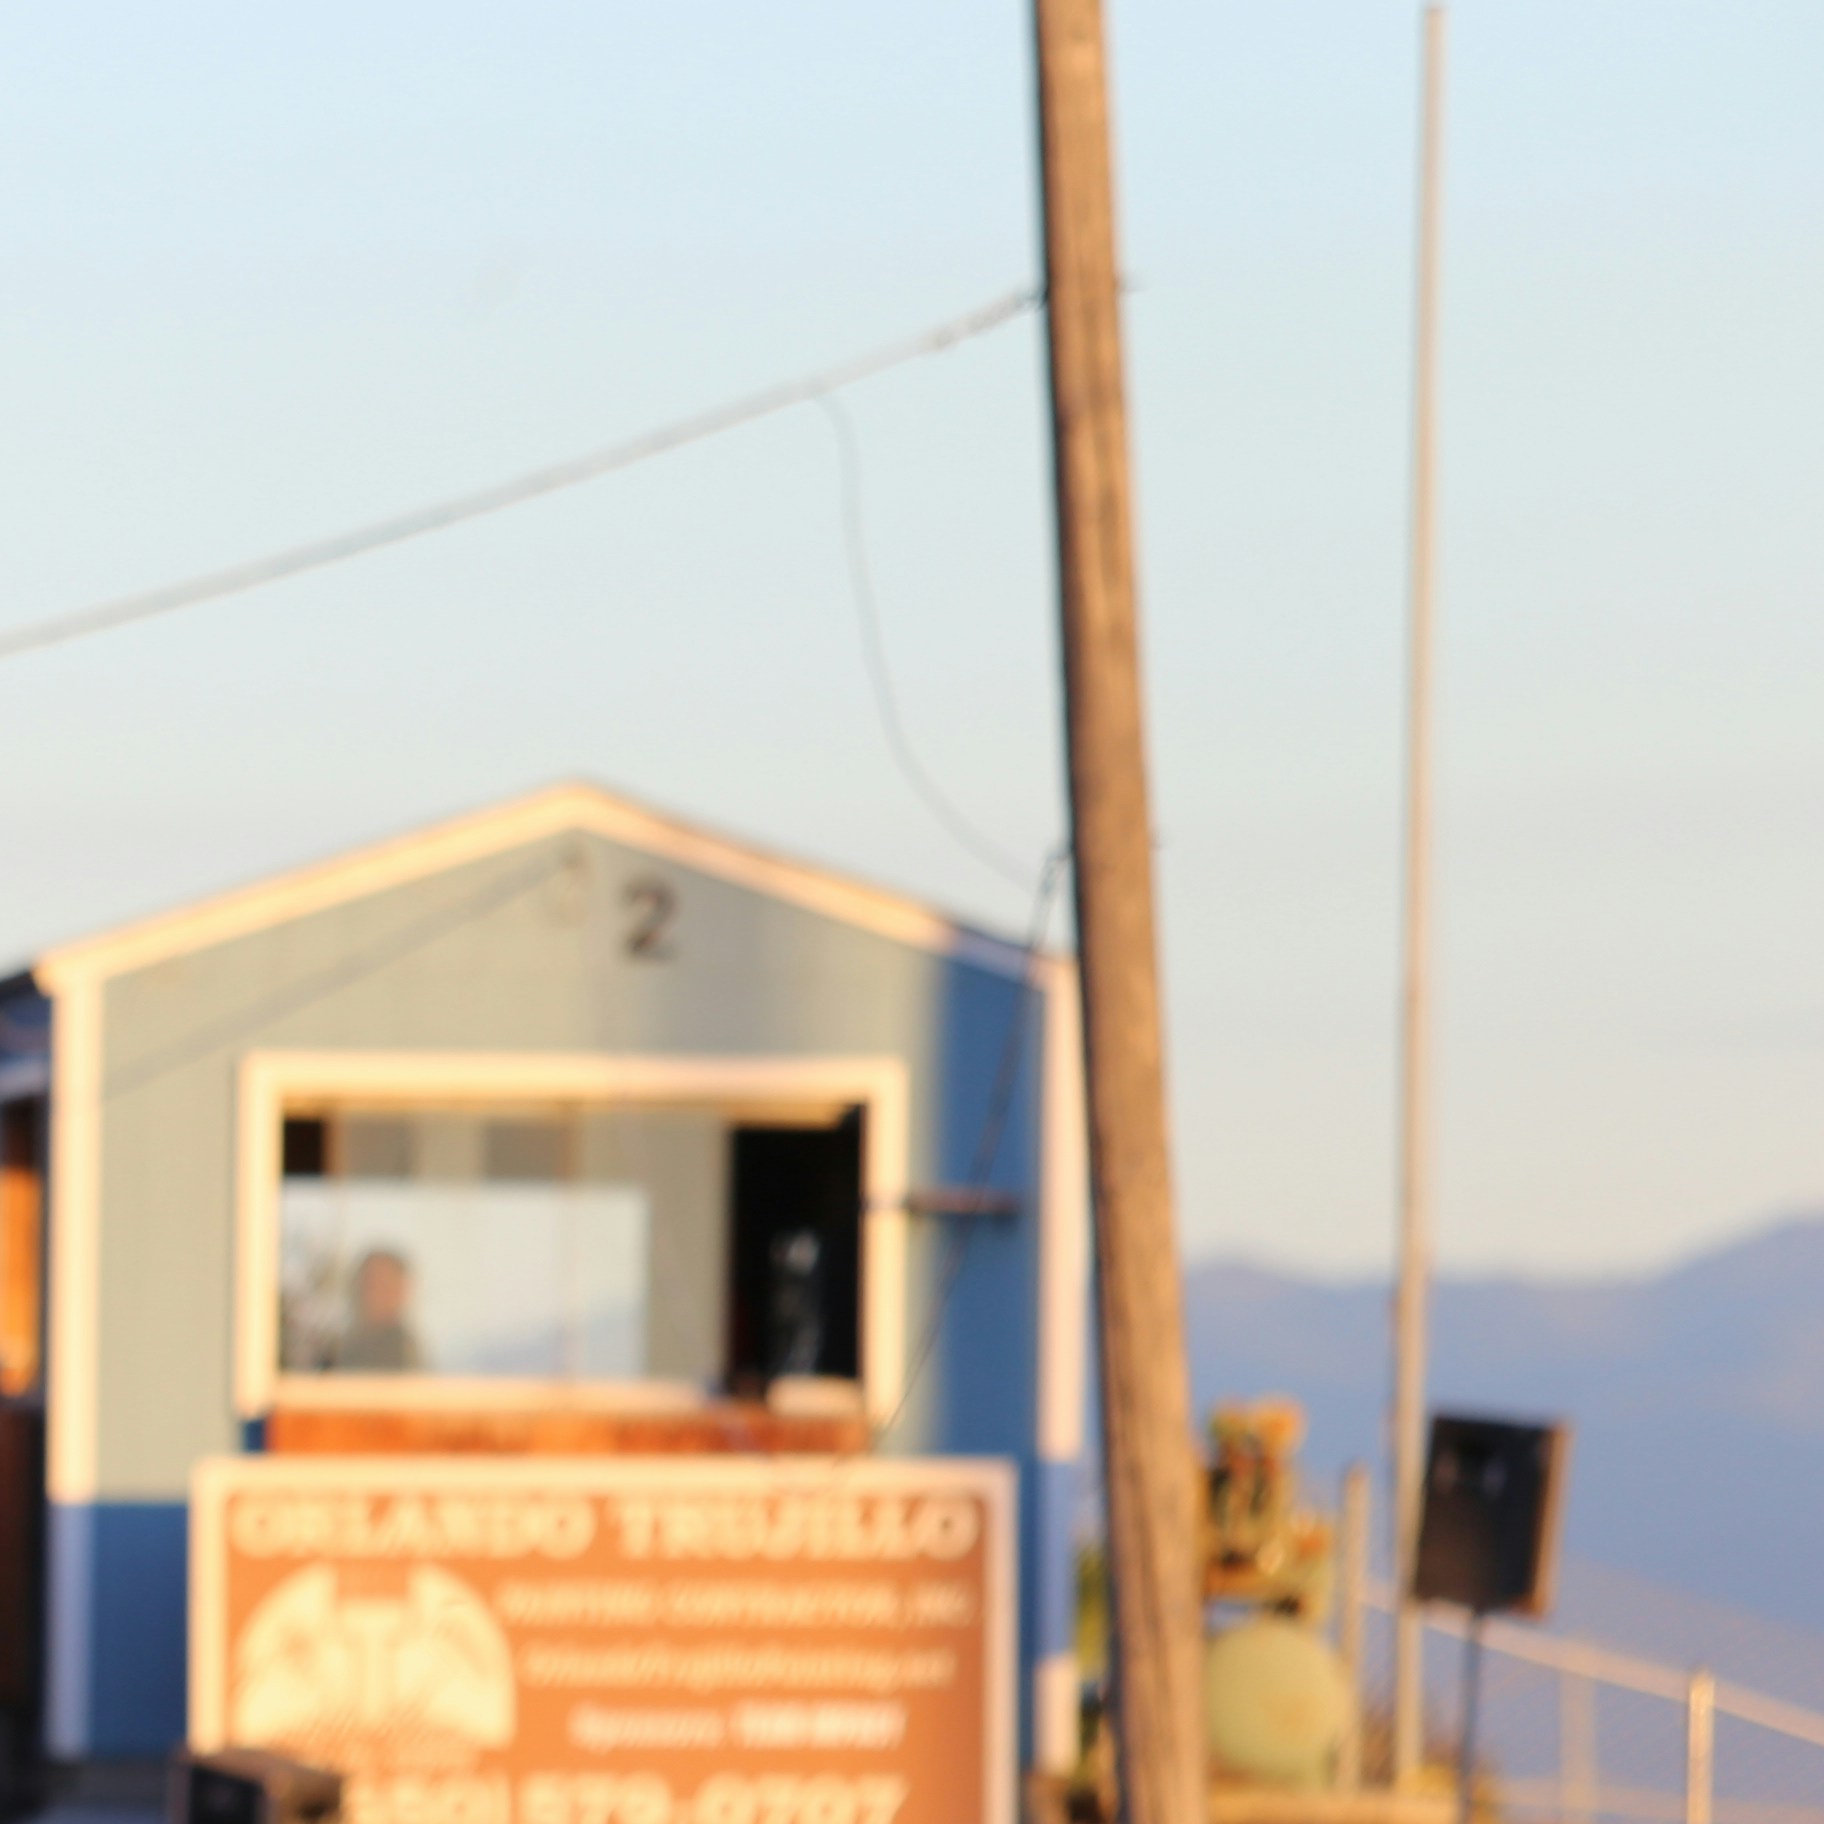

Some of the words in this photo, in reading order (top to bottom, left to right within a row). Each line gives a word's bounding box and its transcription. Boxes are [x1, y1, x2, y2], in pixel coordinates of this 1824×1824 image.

[619, 880, 679, 961] 2
[235, 1498, 592, 1557] ORLANDO
[615, 1498, 977, 1558] TRUJILLO
